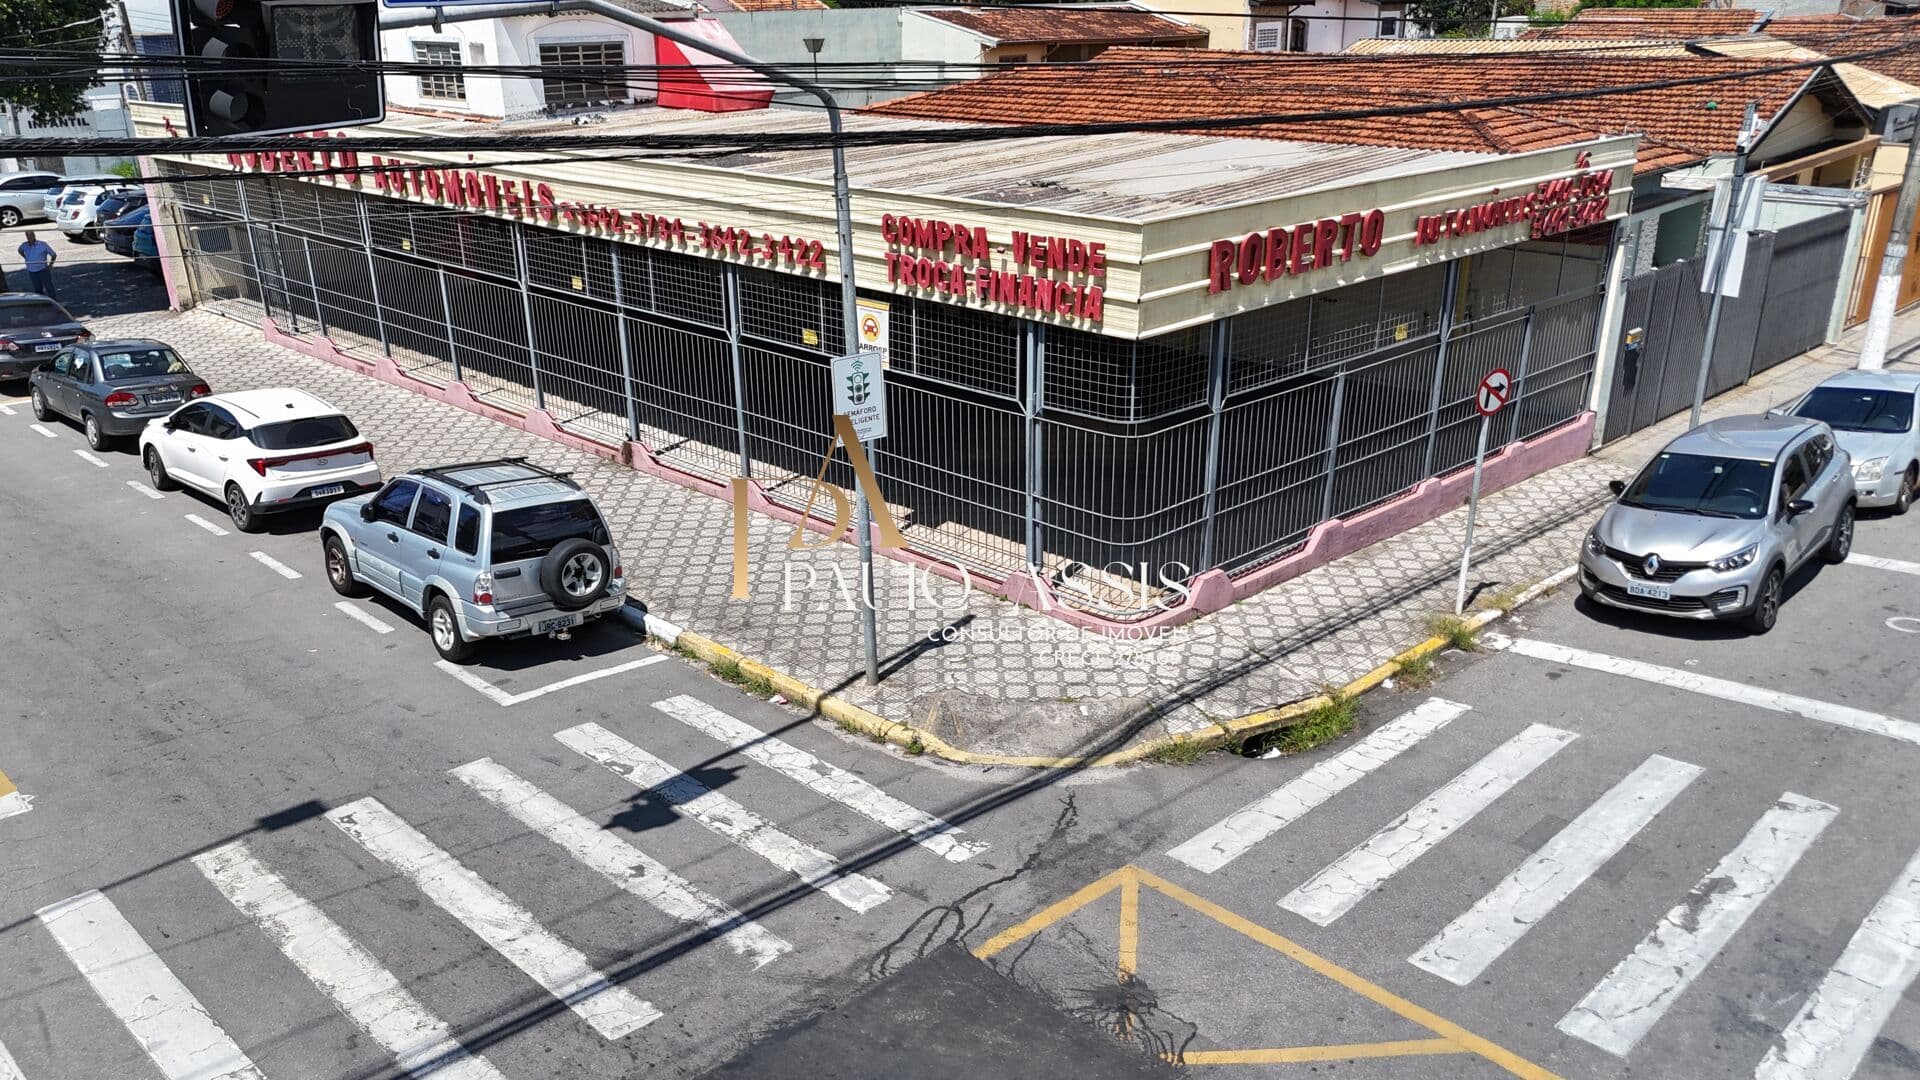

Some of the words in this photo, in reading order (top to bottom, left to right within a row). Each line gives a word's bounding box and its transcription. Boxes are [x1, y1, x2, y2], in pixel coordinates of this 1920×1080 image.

[27, 117, 90, 129] INFANTIL
[881, 213, 989, 260] COMPRA
[1011, 231, 1106, 277] VENDE
[1208, 208, 1385, 295] ROBERTO
[858, 342, 888, 354] ARROP
